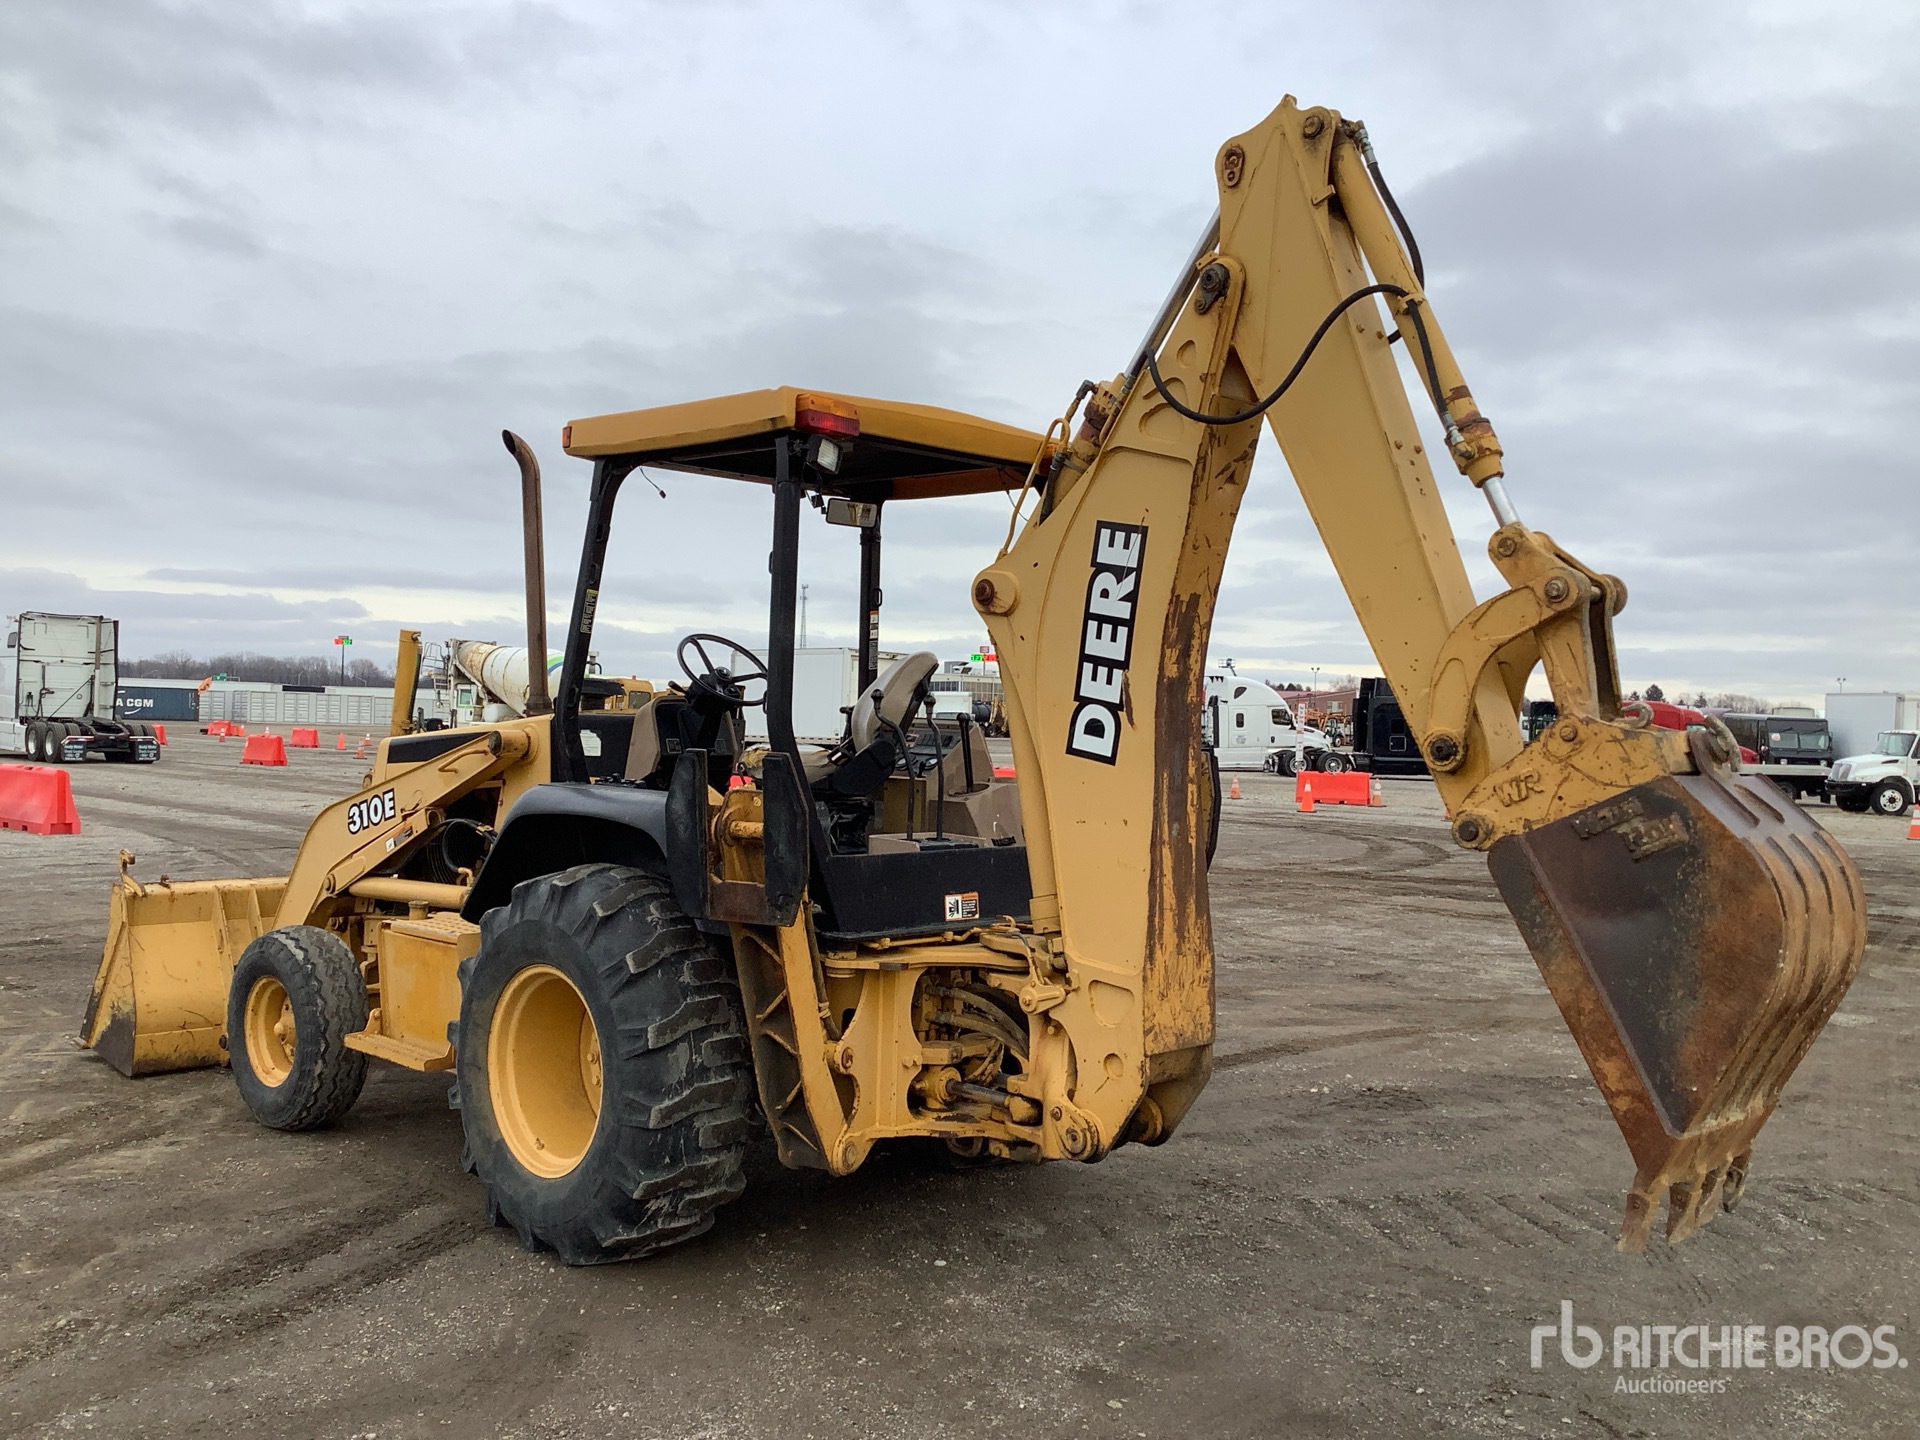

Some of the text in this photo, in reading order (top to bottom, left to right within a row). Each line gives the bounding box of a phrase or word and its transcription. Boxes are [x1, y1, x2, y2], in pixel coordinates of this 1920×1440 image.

[1070, 526, 1144, 759] DEERE
[126, 698, 154, 708] CGM
[348, 789, 395, 834] 310E
